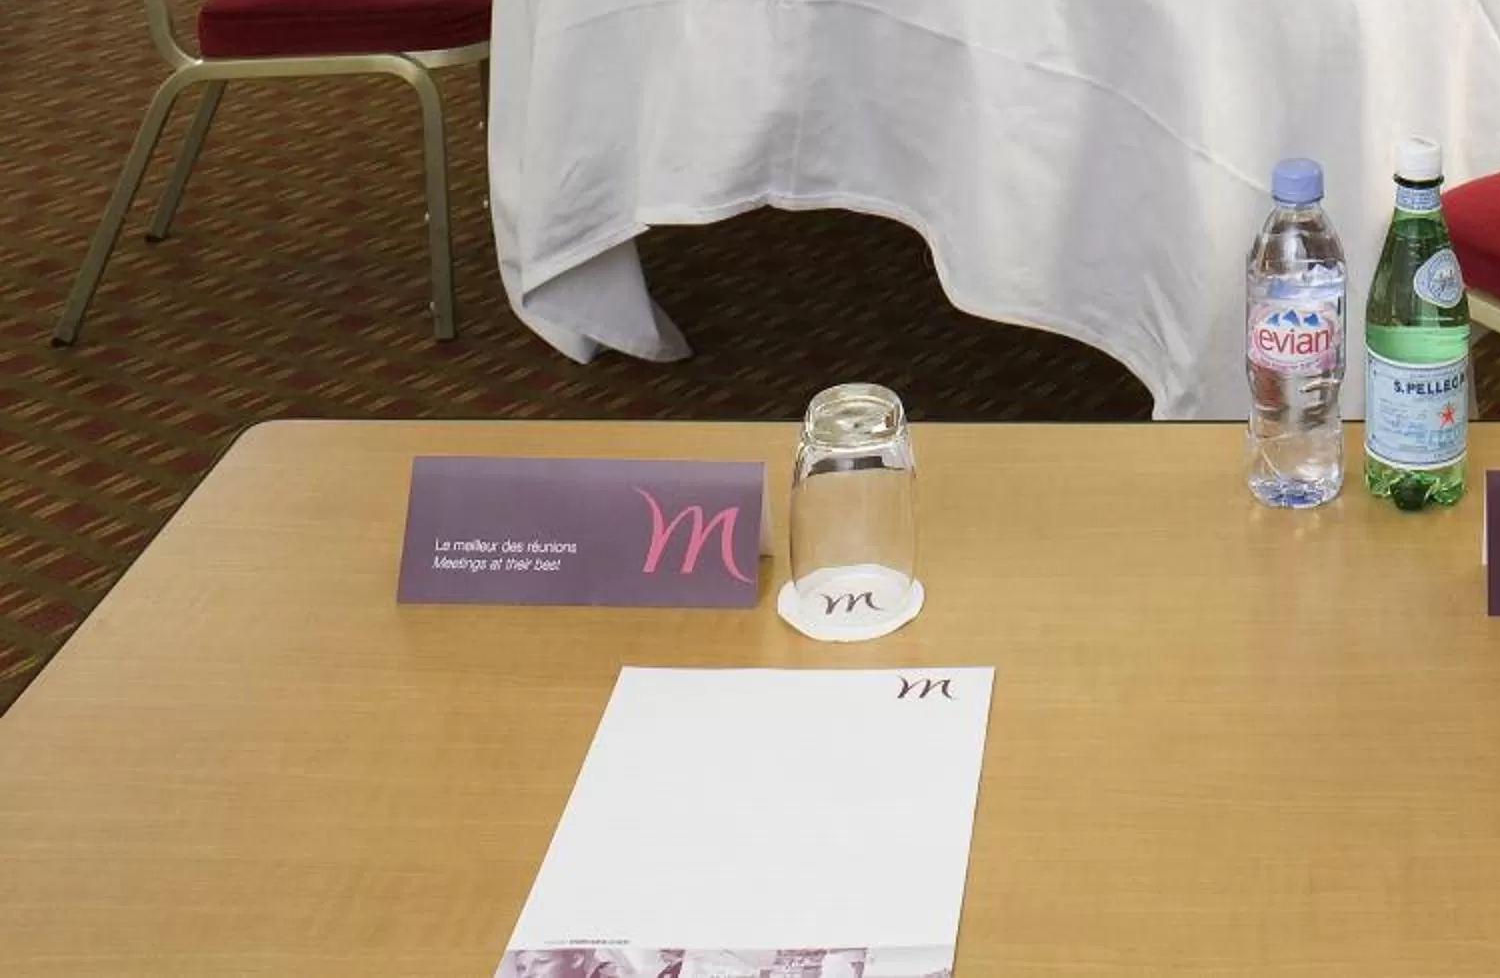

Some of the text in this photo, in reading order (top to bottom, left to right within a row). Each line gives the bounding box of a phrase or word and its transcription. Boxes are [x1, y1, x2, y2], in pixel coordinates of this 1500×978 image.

[1259, 328, 1331, 355] evian
[435, 537, 451, 551] Le
[453, 538, 497, 553] meilleur
[501, 538, 525, 553] des
[432, 555, 561, 572] Meetings at their best
